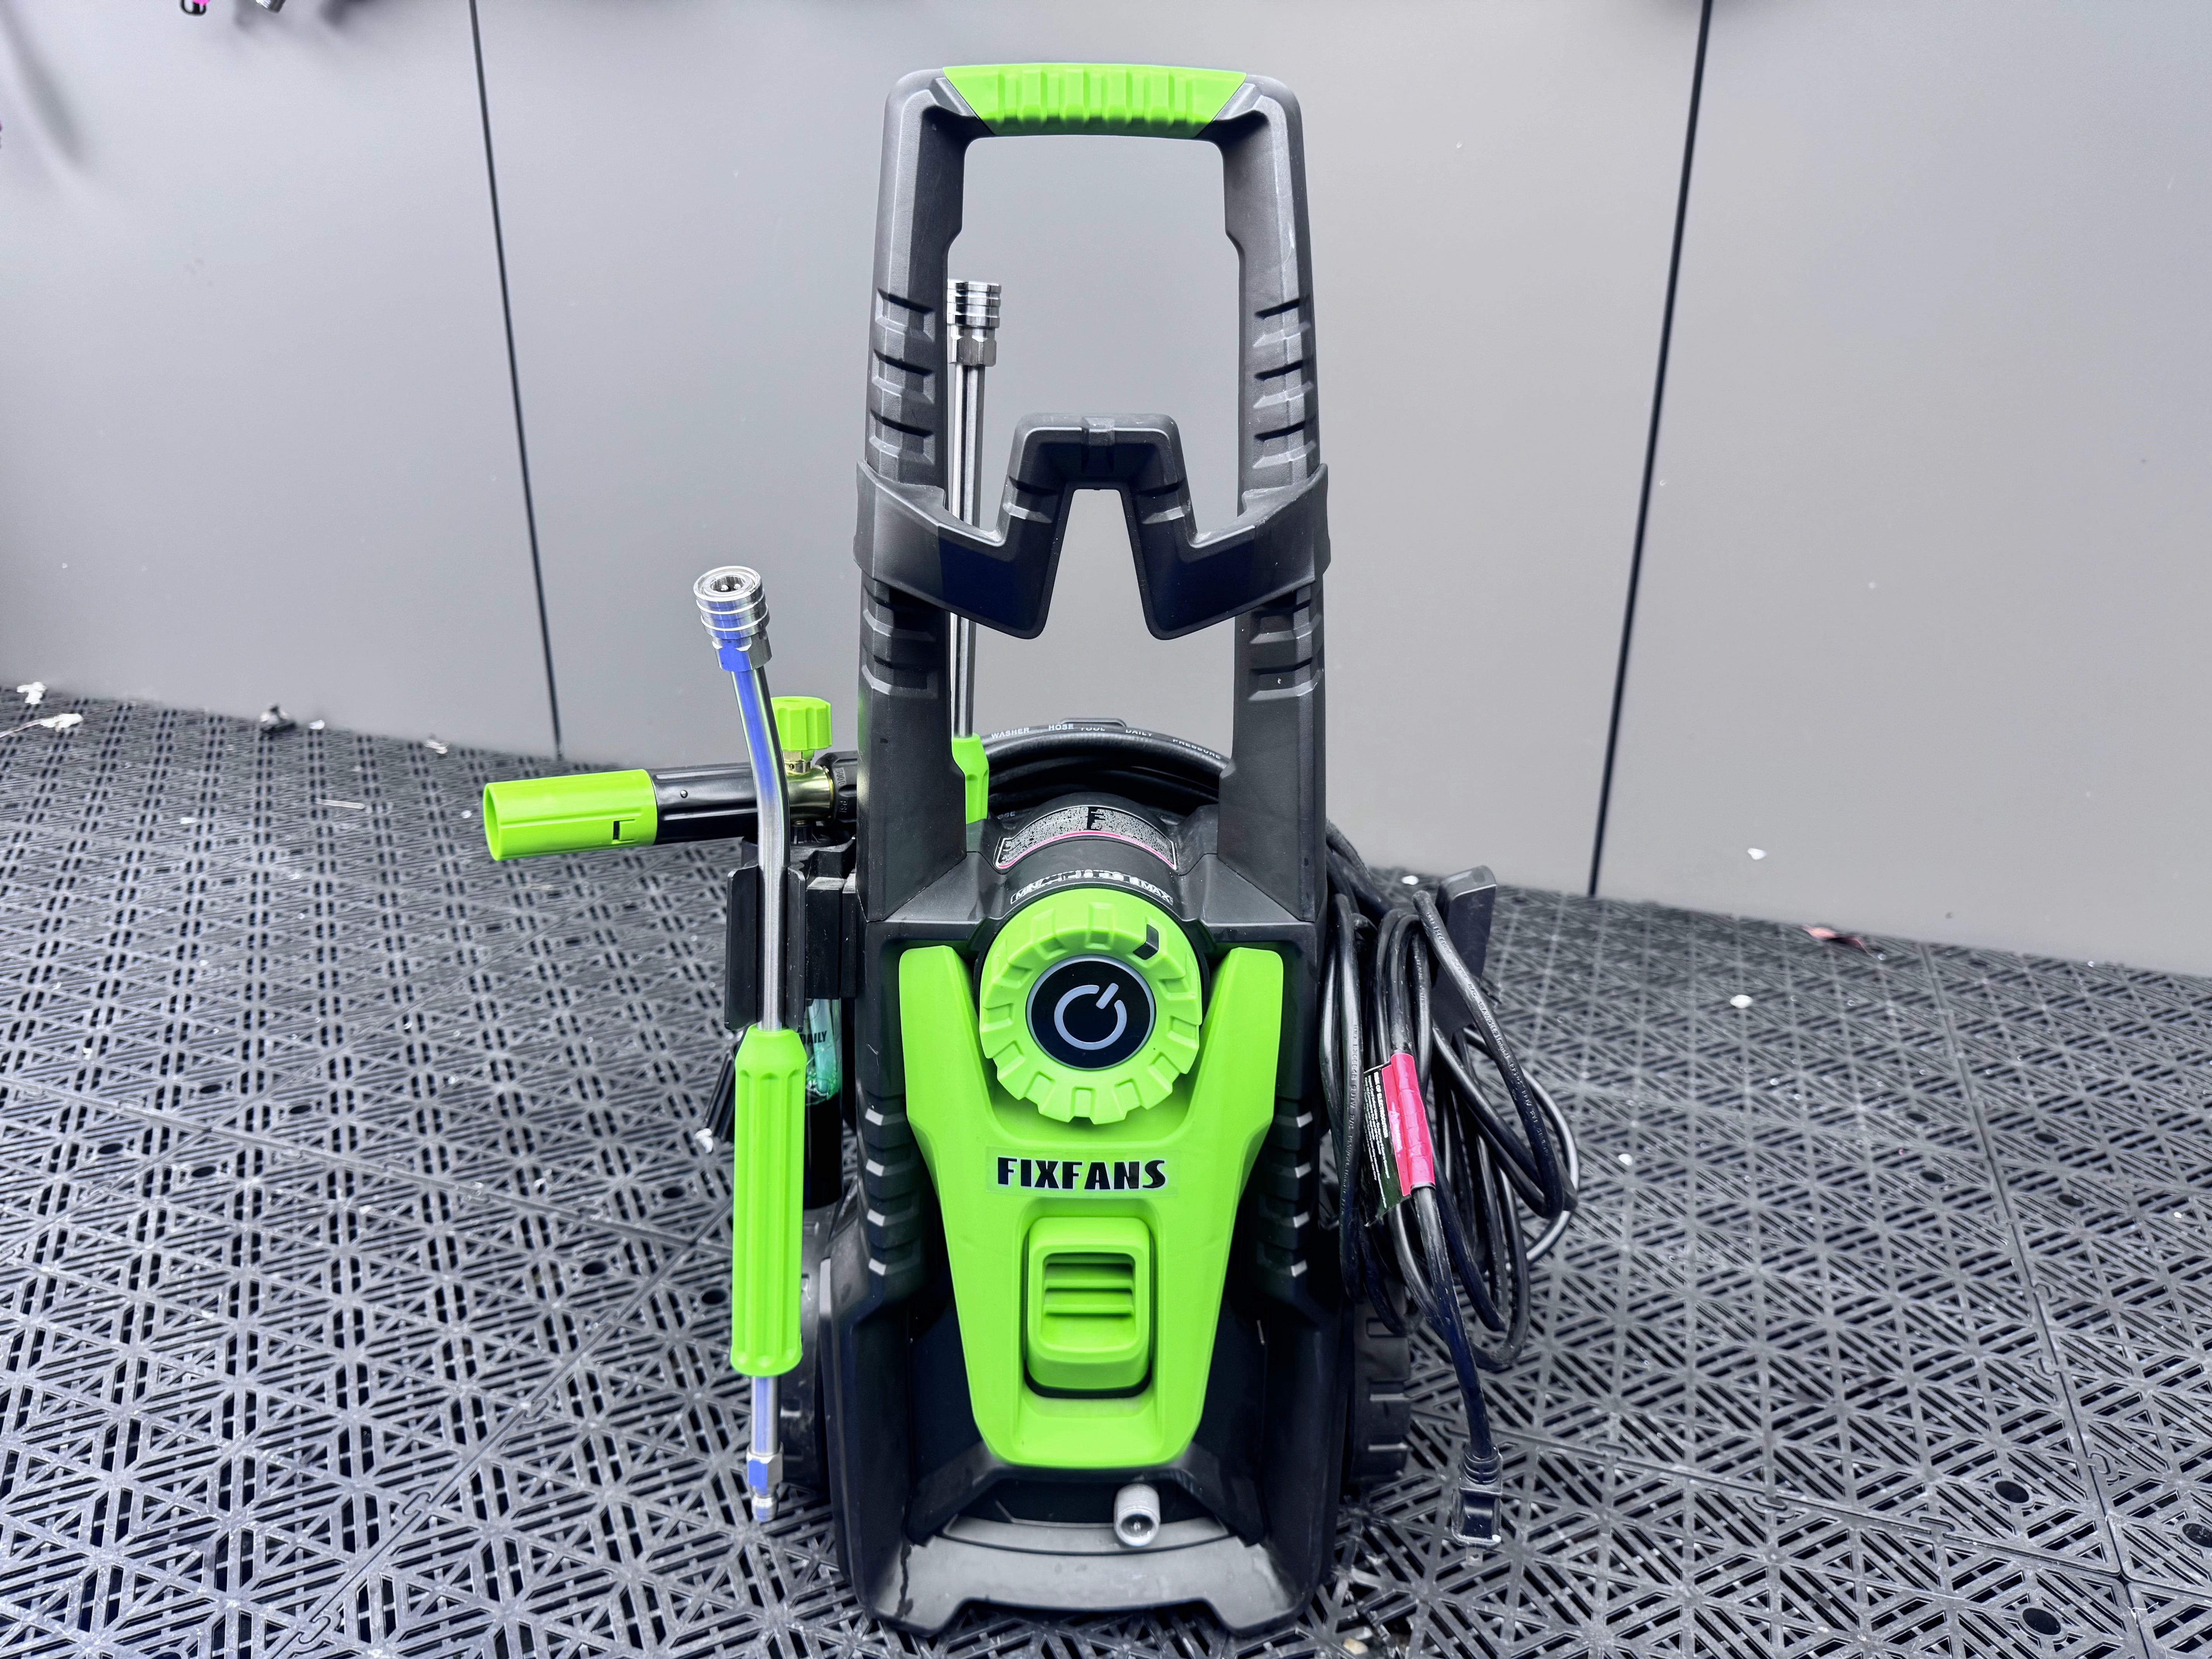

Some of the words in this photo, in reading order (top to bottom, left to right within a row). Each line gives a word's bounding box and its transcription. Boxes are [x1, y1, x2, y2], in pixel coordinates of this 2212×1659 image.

[991, 727, 1030, 739] WASHER
[839, 800, 848, 813] PSI
[1015, 882, 1039, 900] MIN
[1140, 881, 1172, 903] MAX
[799, 1030, 828, 1044] DAILY
[1375, 1084, 1381, 1092] OF
[997, 1156, 1166, 1190] FIXFANS
